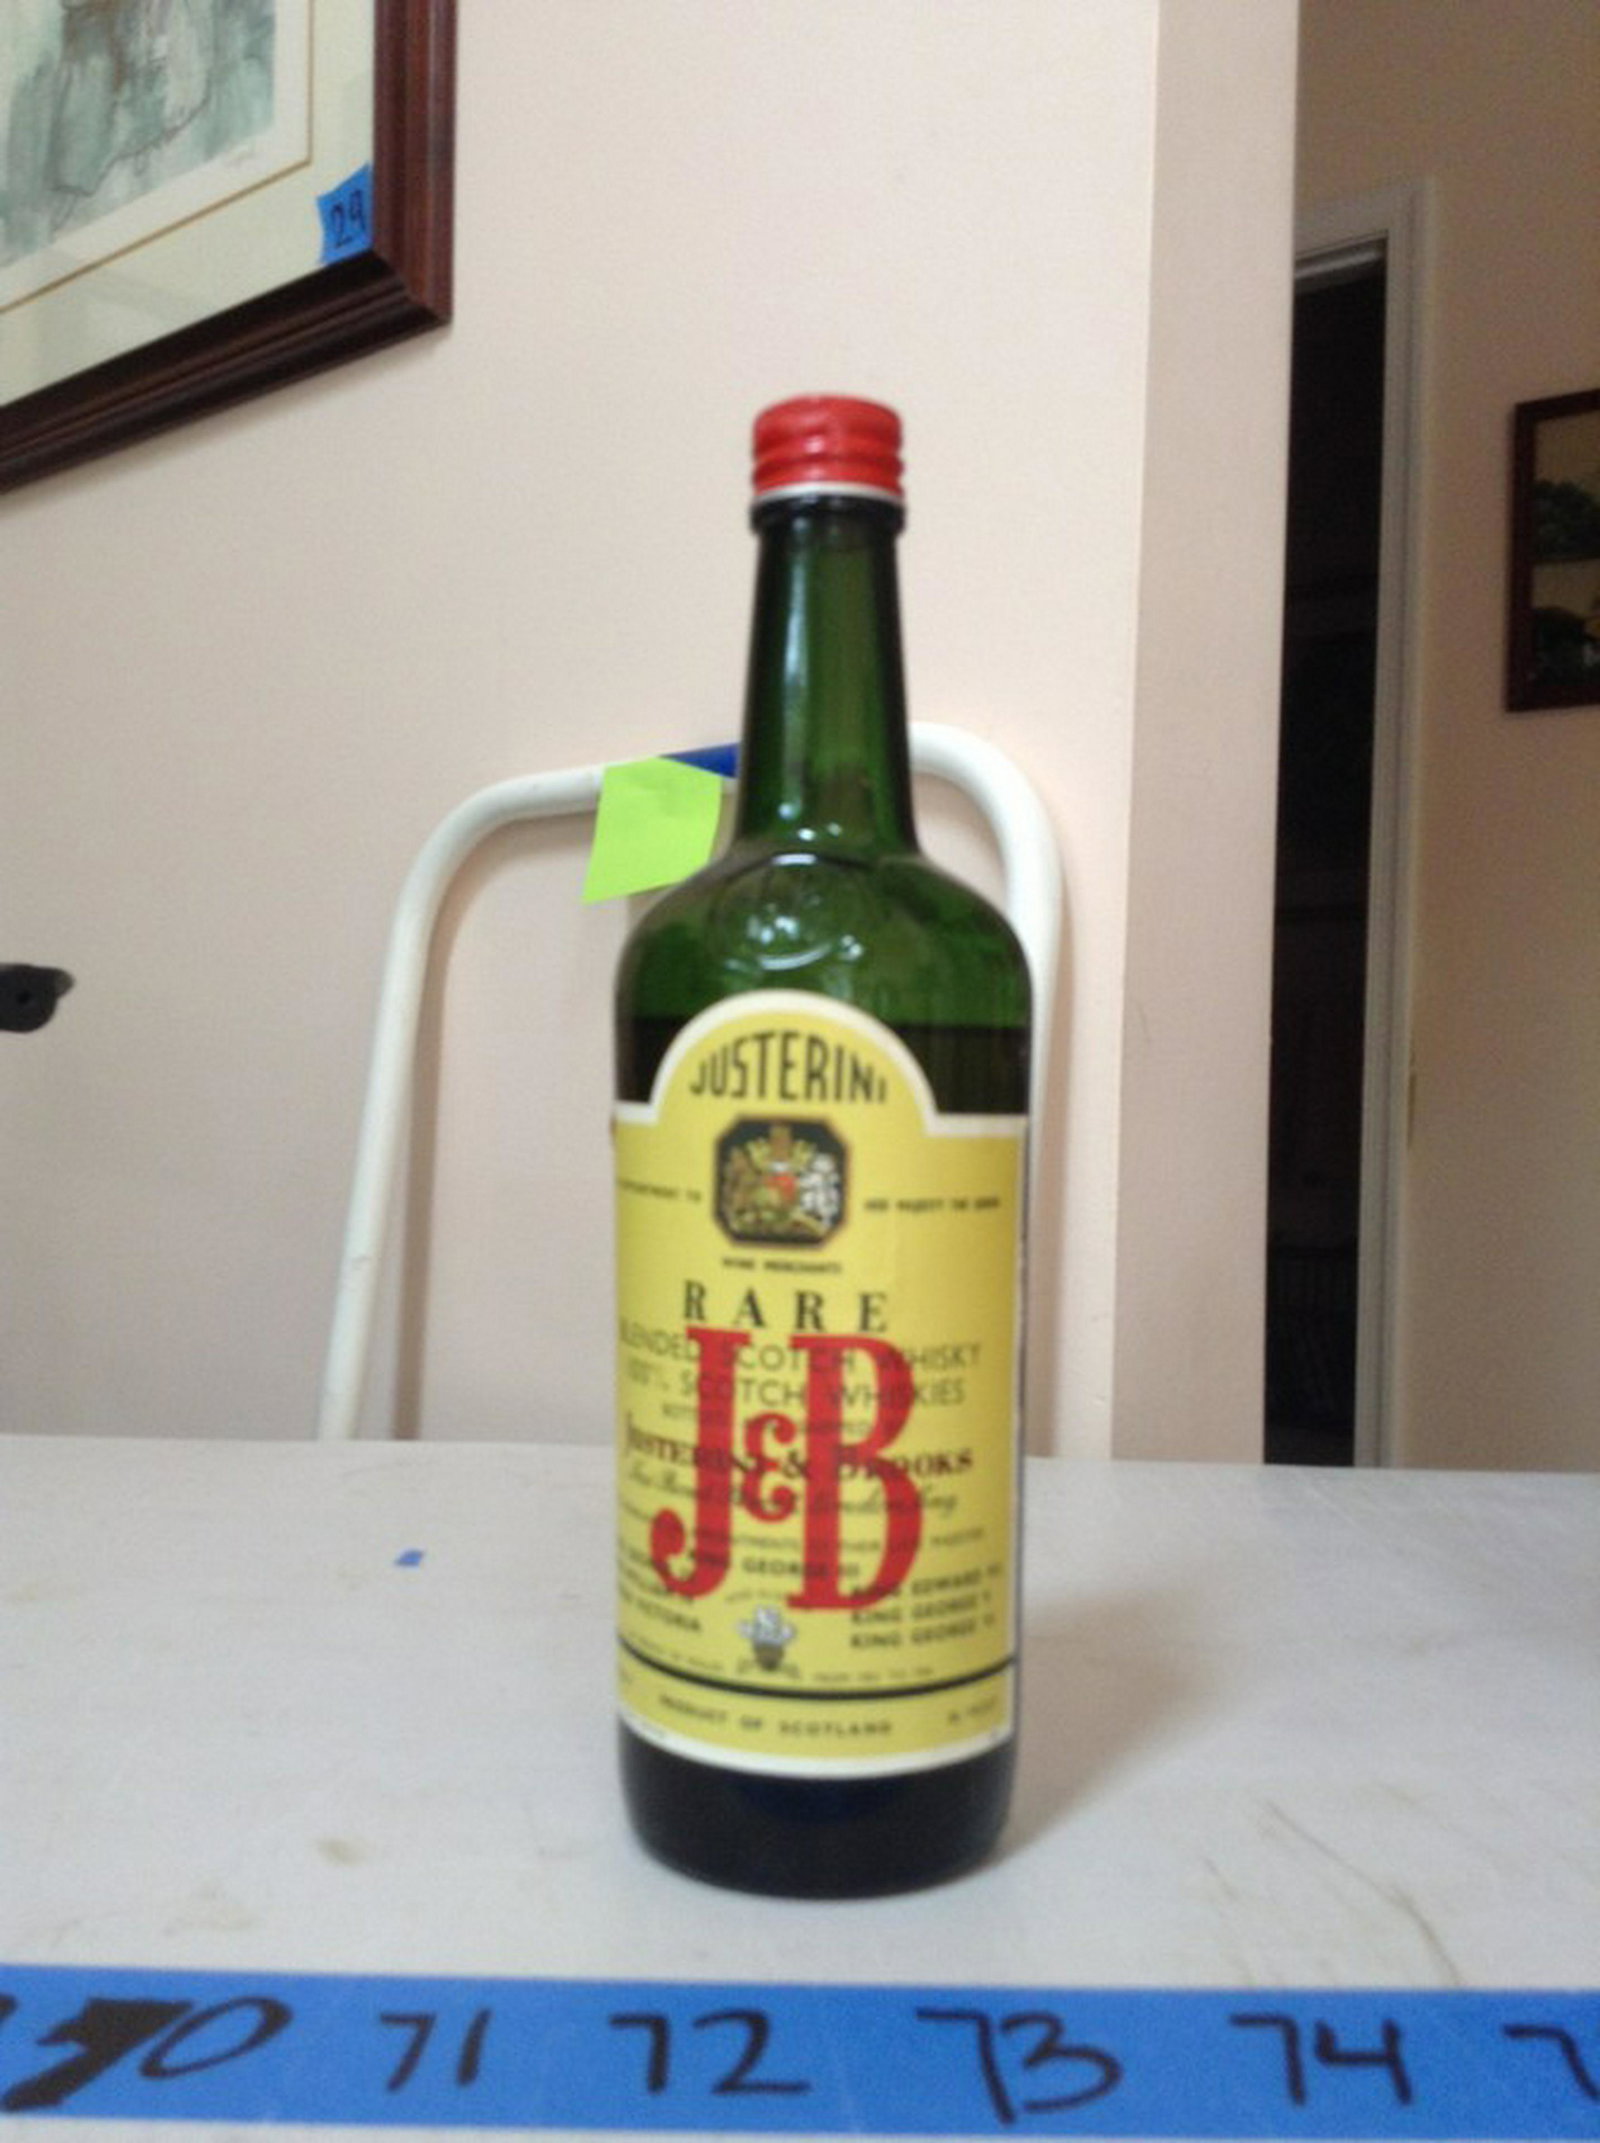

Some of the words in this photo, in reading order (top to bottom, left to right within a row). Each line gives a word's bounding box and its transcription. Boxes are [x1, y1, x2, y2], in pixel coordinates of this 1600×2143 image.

[331, 188, 367, 248] 29
[690, 1031, 887, 1103] JUSTERINI
[684, 1280, 888, 1333] RARE
[650, 1326, 923, 1612] J&B
[378, 2008, 492, 2092] 71
[608, 2008, 812, 2094] 72
[914, 2007, 1123, 2125] 73
[1228, 2012, 1413, 2106] 74
